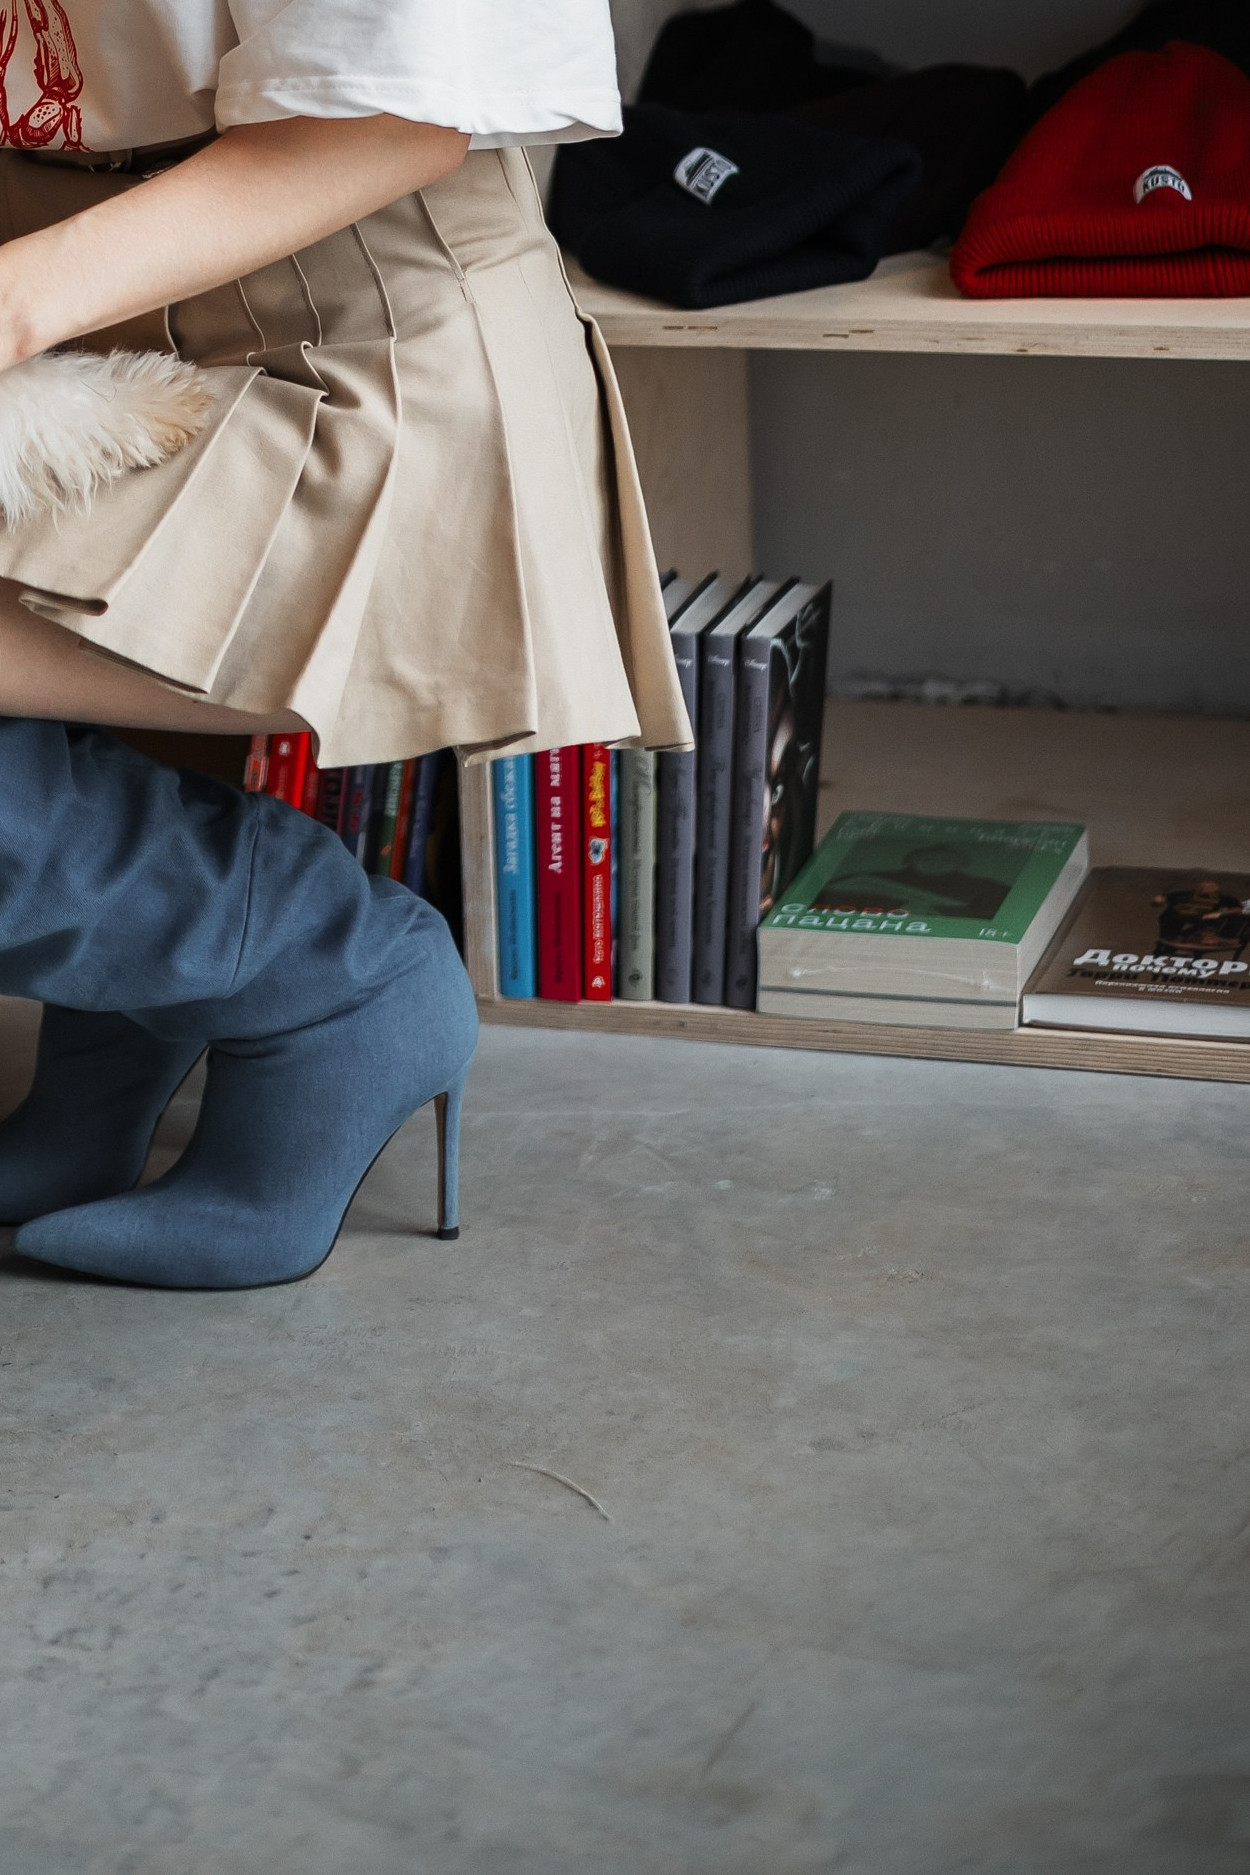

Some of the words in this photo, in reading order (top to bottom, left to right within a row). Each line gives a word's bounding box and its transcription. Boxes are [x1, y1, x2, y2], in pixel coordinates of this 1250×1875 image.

[549, 797, 561, 819] на
[502, 813, 520, 875] Загадка
[548, 822, 563, 874] Агент
[772, 913, 932, 933] пацана
[1112, 964, 1216, 979] почему
